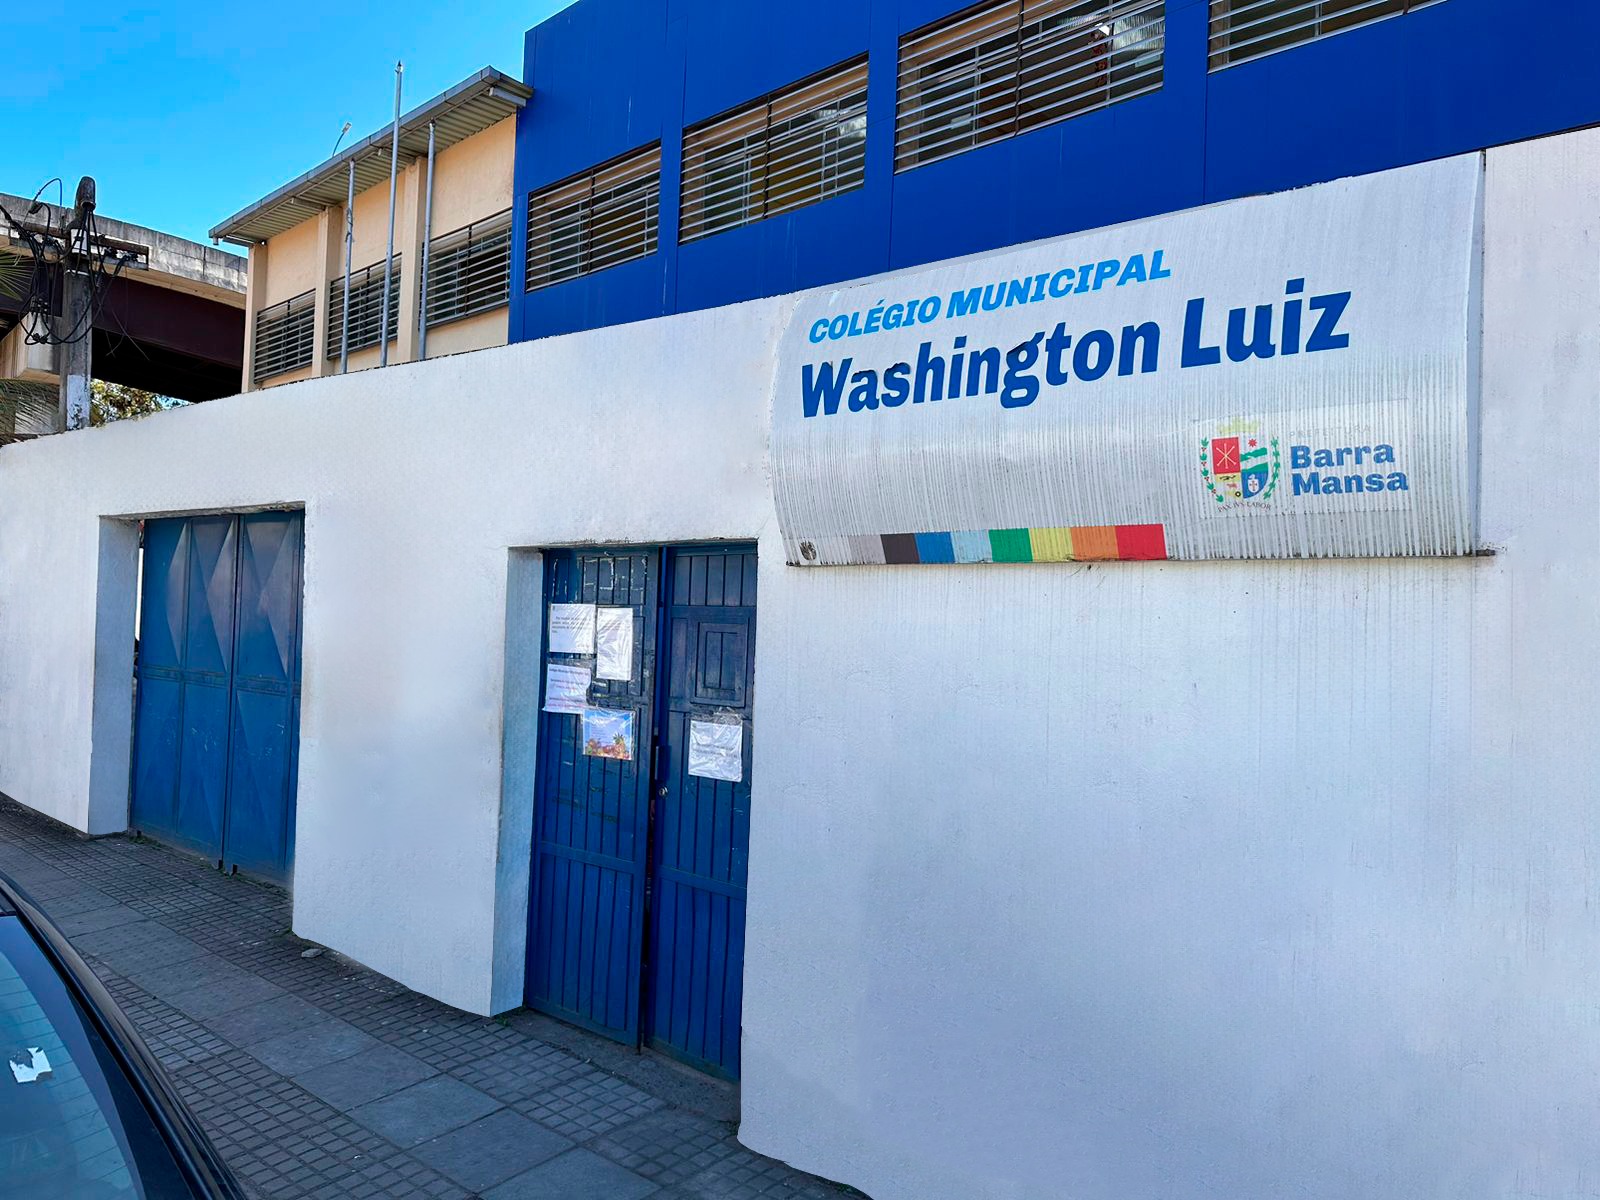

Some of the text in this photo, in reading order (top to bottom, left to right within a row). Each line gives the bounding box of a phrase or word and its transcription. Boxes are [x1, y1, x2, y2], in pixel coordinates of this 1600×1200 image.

[809, 250, 1171, 343] COLÉGIO MUNICIPAL
[801, 278, 1352, 418] Washington Luiz
[1291, 444, 1396, 470] Barra
[1291, 471, 1409, 497] Mansa
